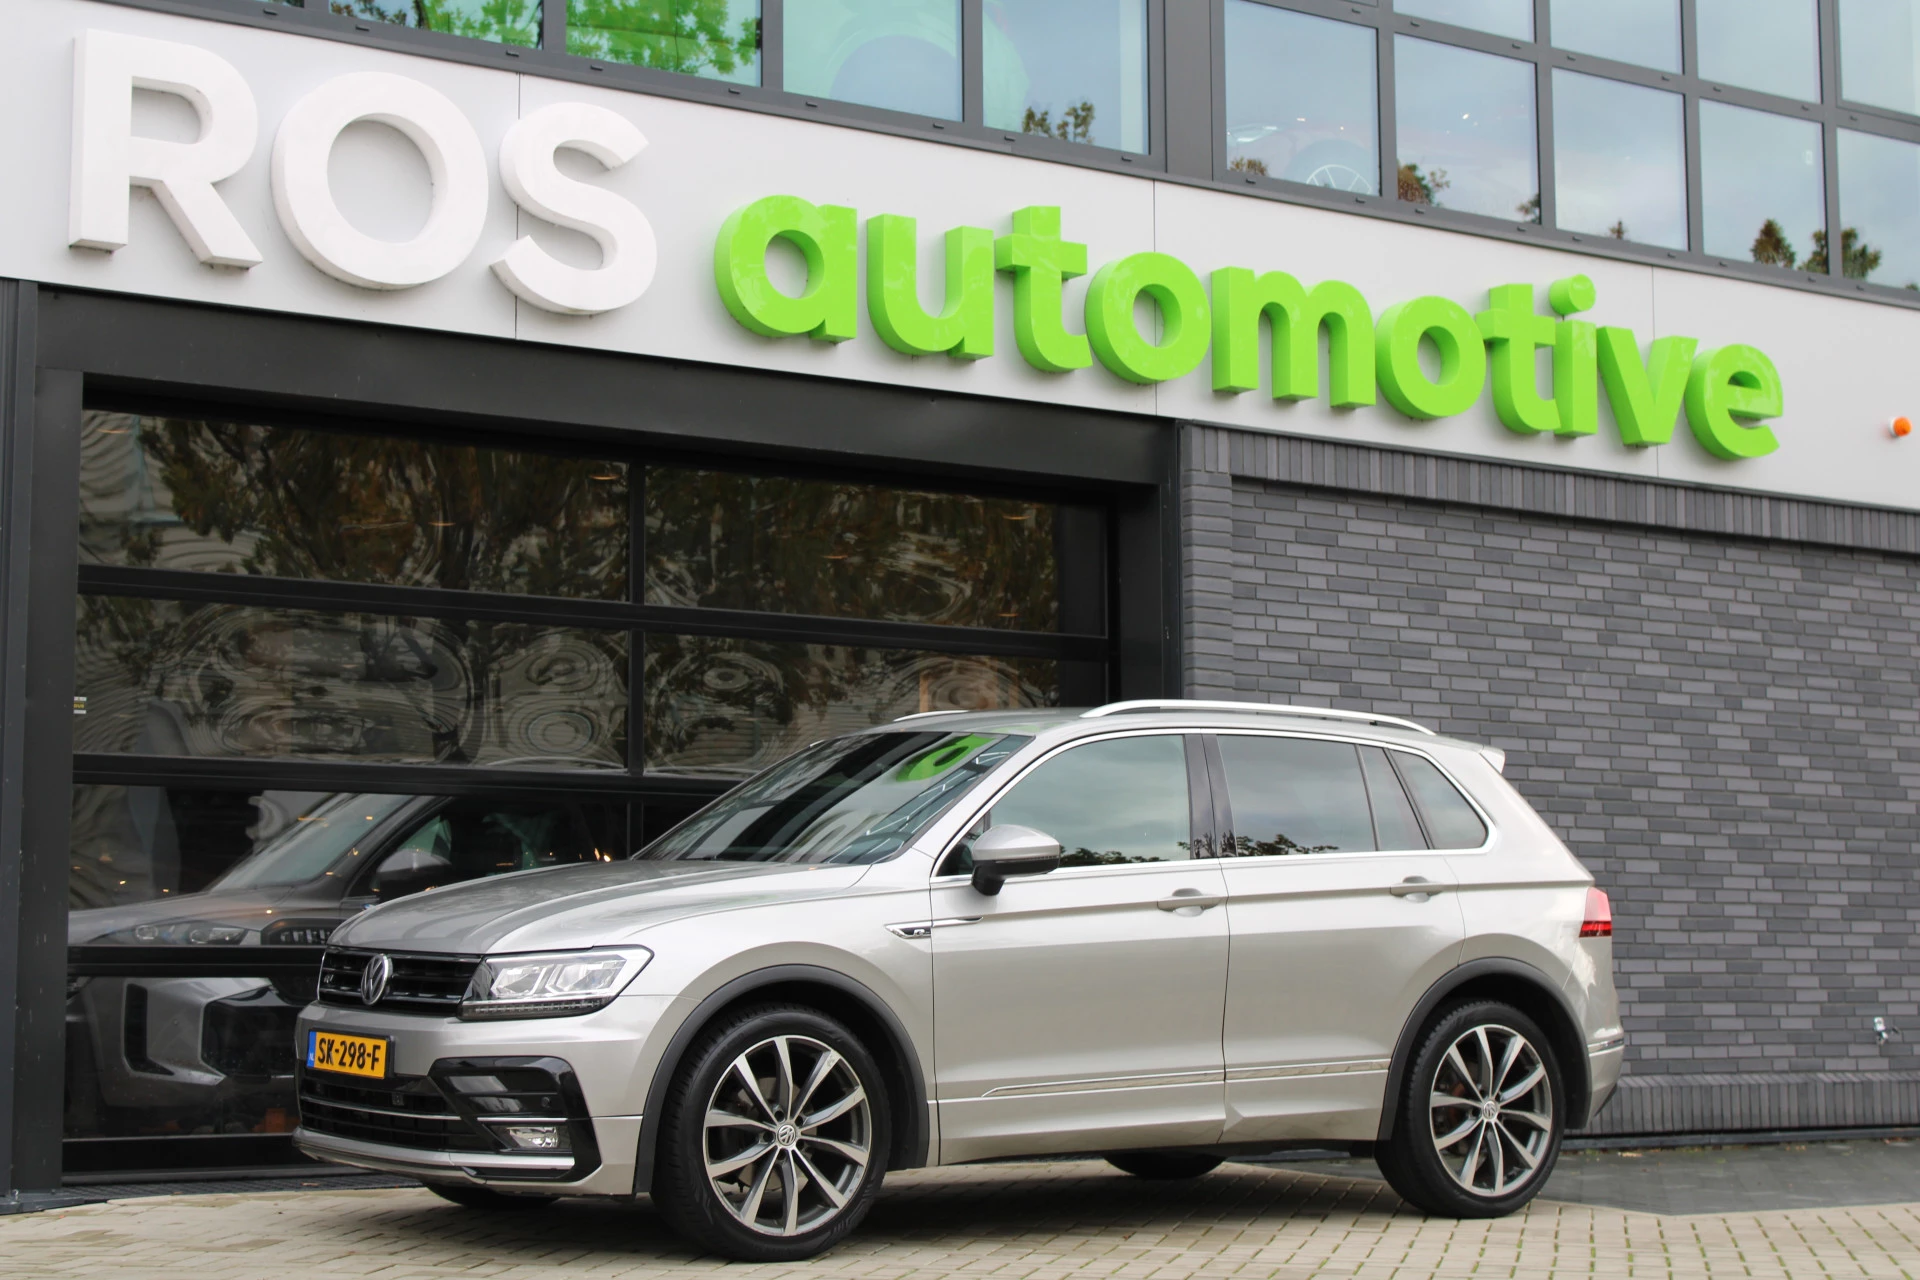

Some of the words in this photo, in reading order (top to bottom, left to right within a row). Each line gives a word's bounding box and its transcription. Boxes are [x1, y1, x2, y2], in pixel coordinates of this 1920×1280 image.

[68, 28, 657, 316] ROS
[714, 195, 1784, 461] automotive
[317, 1037, 381, 1071] SK-298-F
